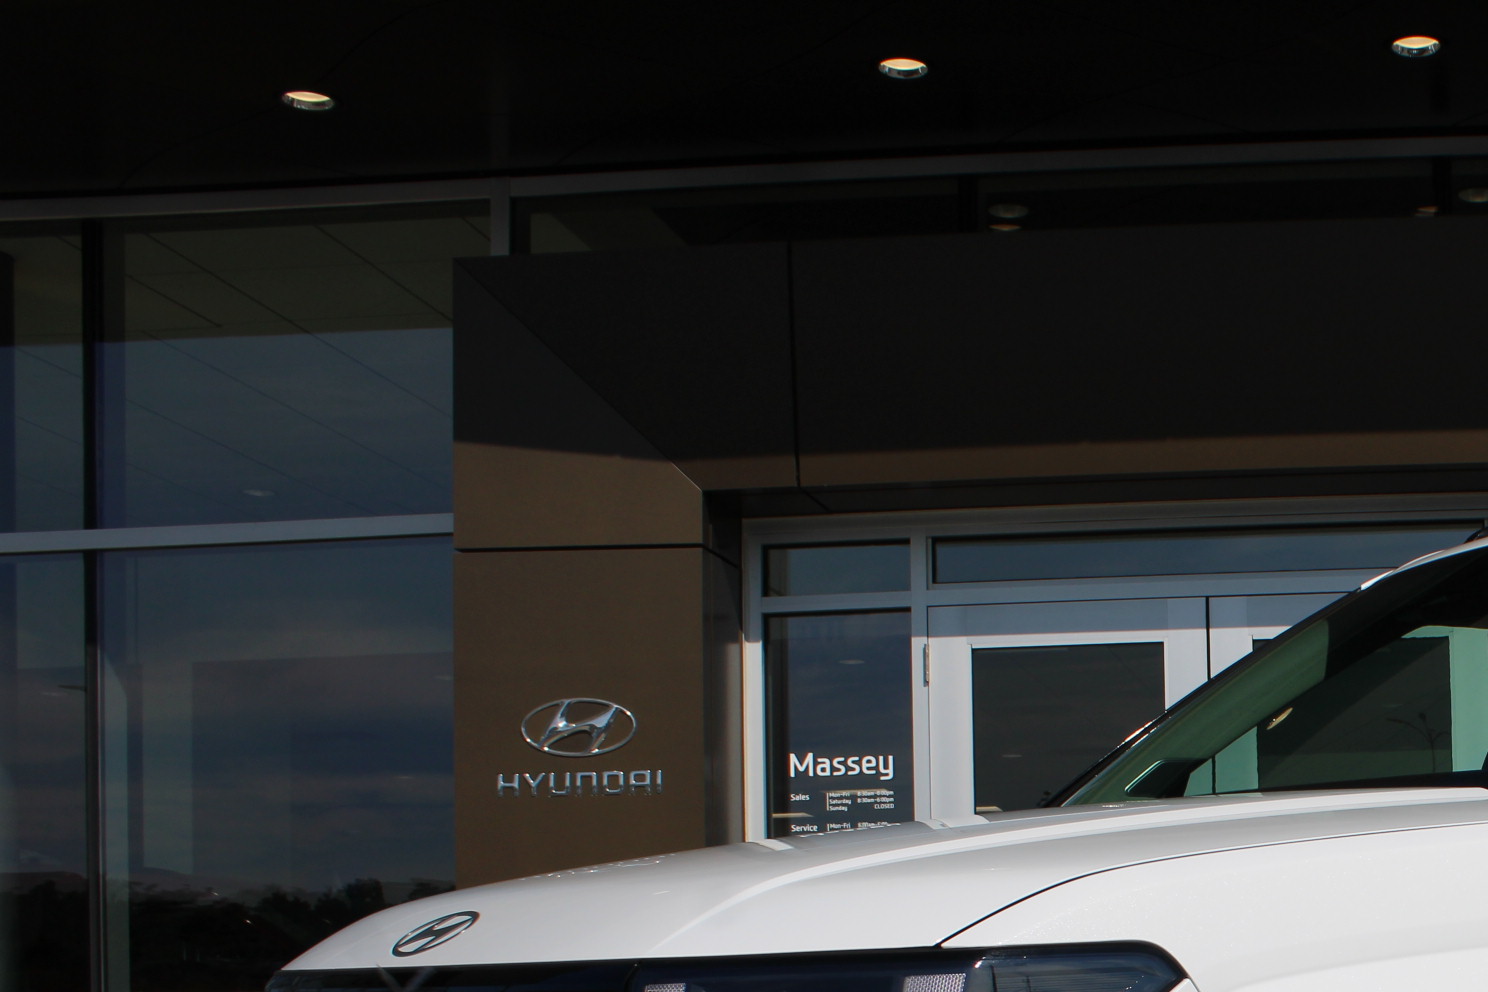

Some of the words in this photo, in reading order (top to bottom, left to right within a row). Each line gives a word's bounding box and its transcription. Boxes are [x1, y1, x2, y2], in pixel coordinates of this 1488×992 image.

[789, 752, 894, 781] Massey
[497, 769, 662, 797] HYUNDAI
[790, 793, 810, 801] Sales
[791, 824, 818, 832] Service
